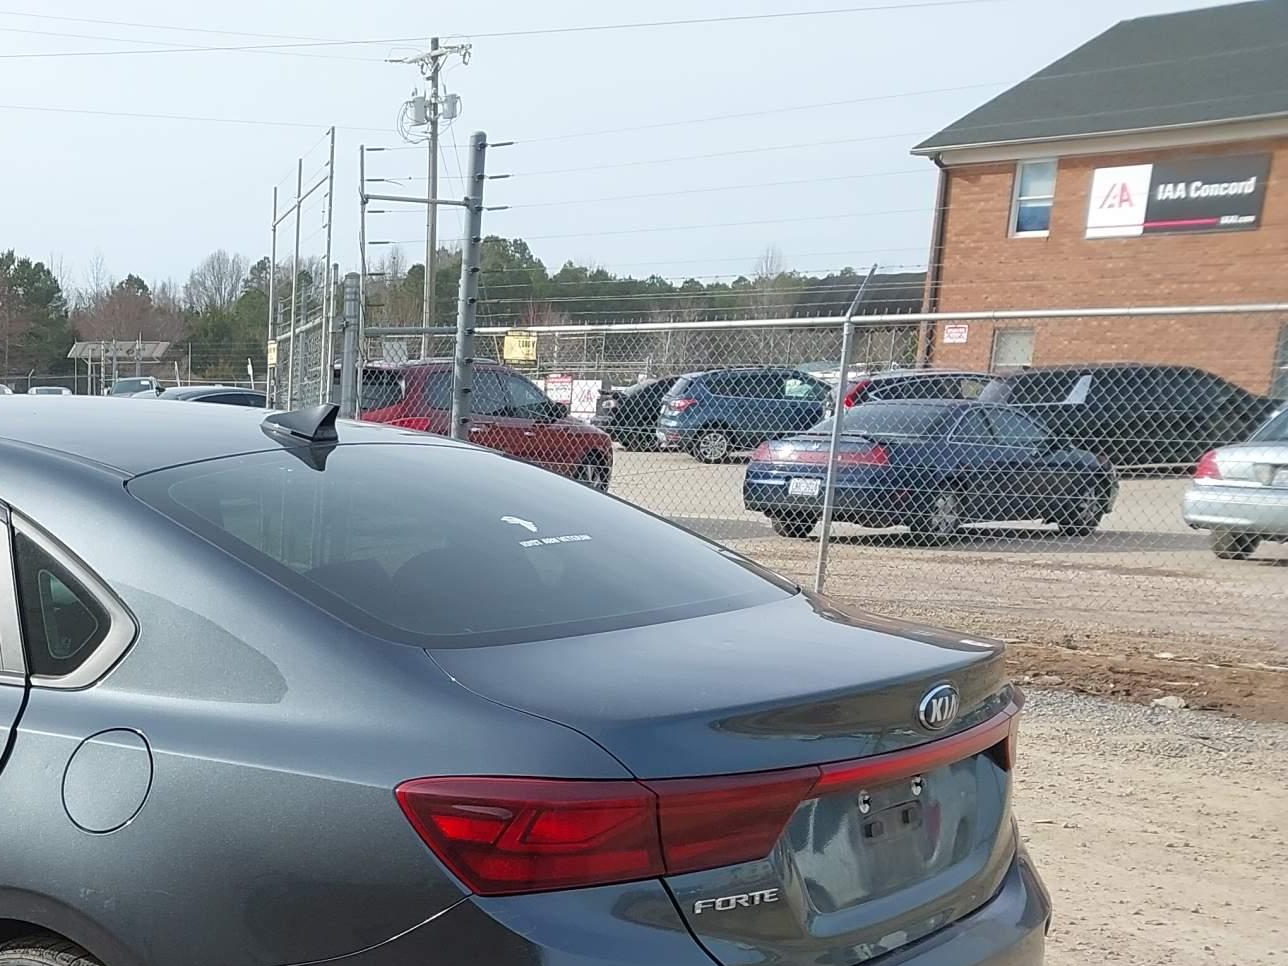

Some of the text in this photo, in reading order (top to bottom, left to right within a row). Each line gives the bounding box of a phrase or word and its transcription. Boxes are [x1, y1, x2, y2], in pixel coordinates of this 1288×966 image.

[1157, 176, 1257, 201] IAA Concord
[929, 693, 959, 723] KIA
[694, 888, 780, 915] FORTE
